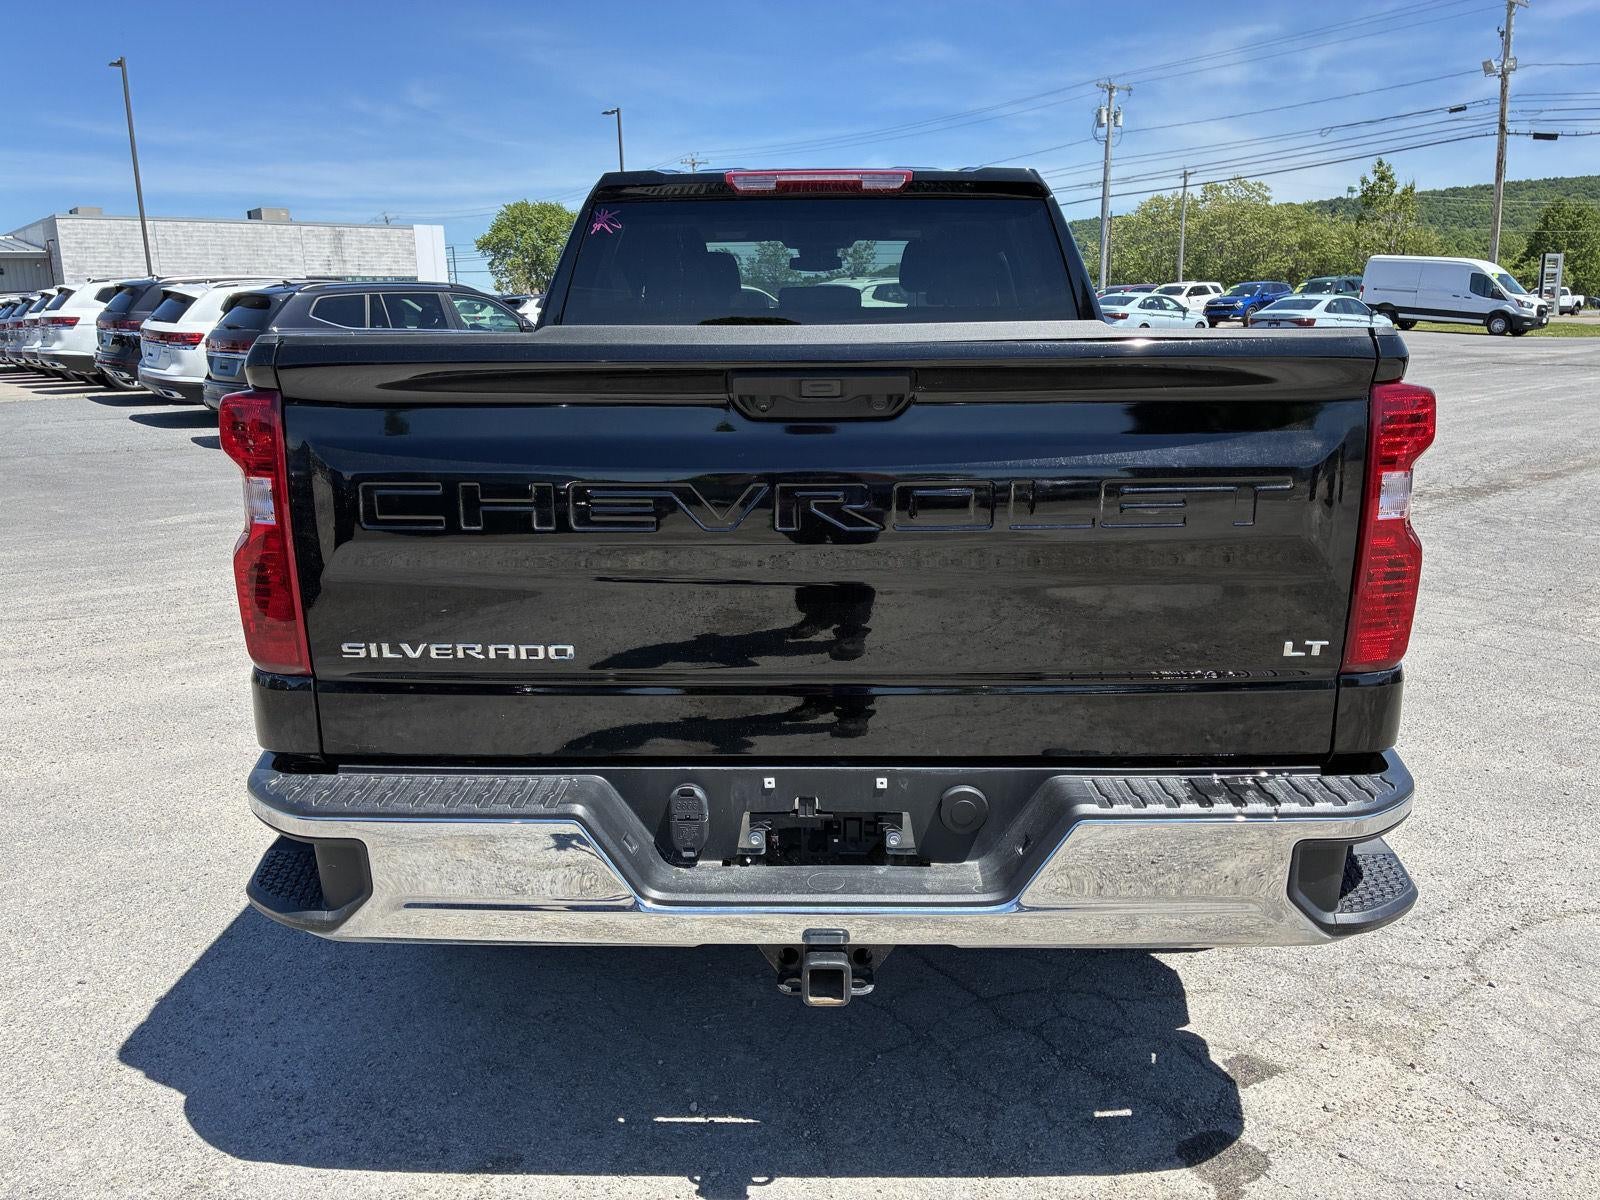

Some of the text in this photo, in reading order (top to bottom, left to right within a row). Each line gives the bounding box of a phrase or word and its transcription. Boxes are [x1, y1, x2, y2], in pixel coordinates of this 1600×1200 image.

[358, 476, 1294, 533] CHEVROLET
[340, 642, 575, 660] SILVERADO
[1282, 640, 1330, 657] LT
